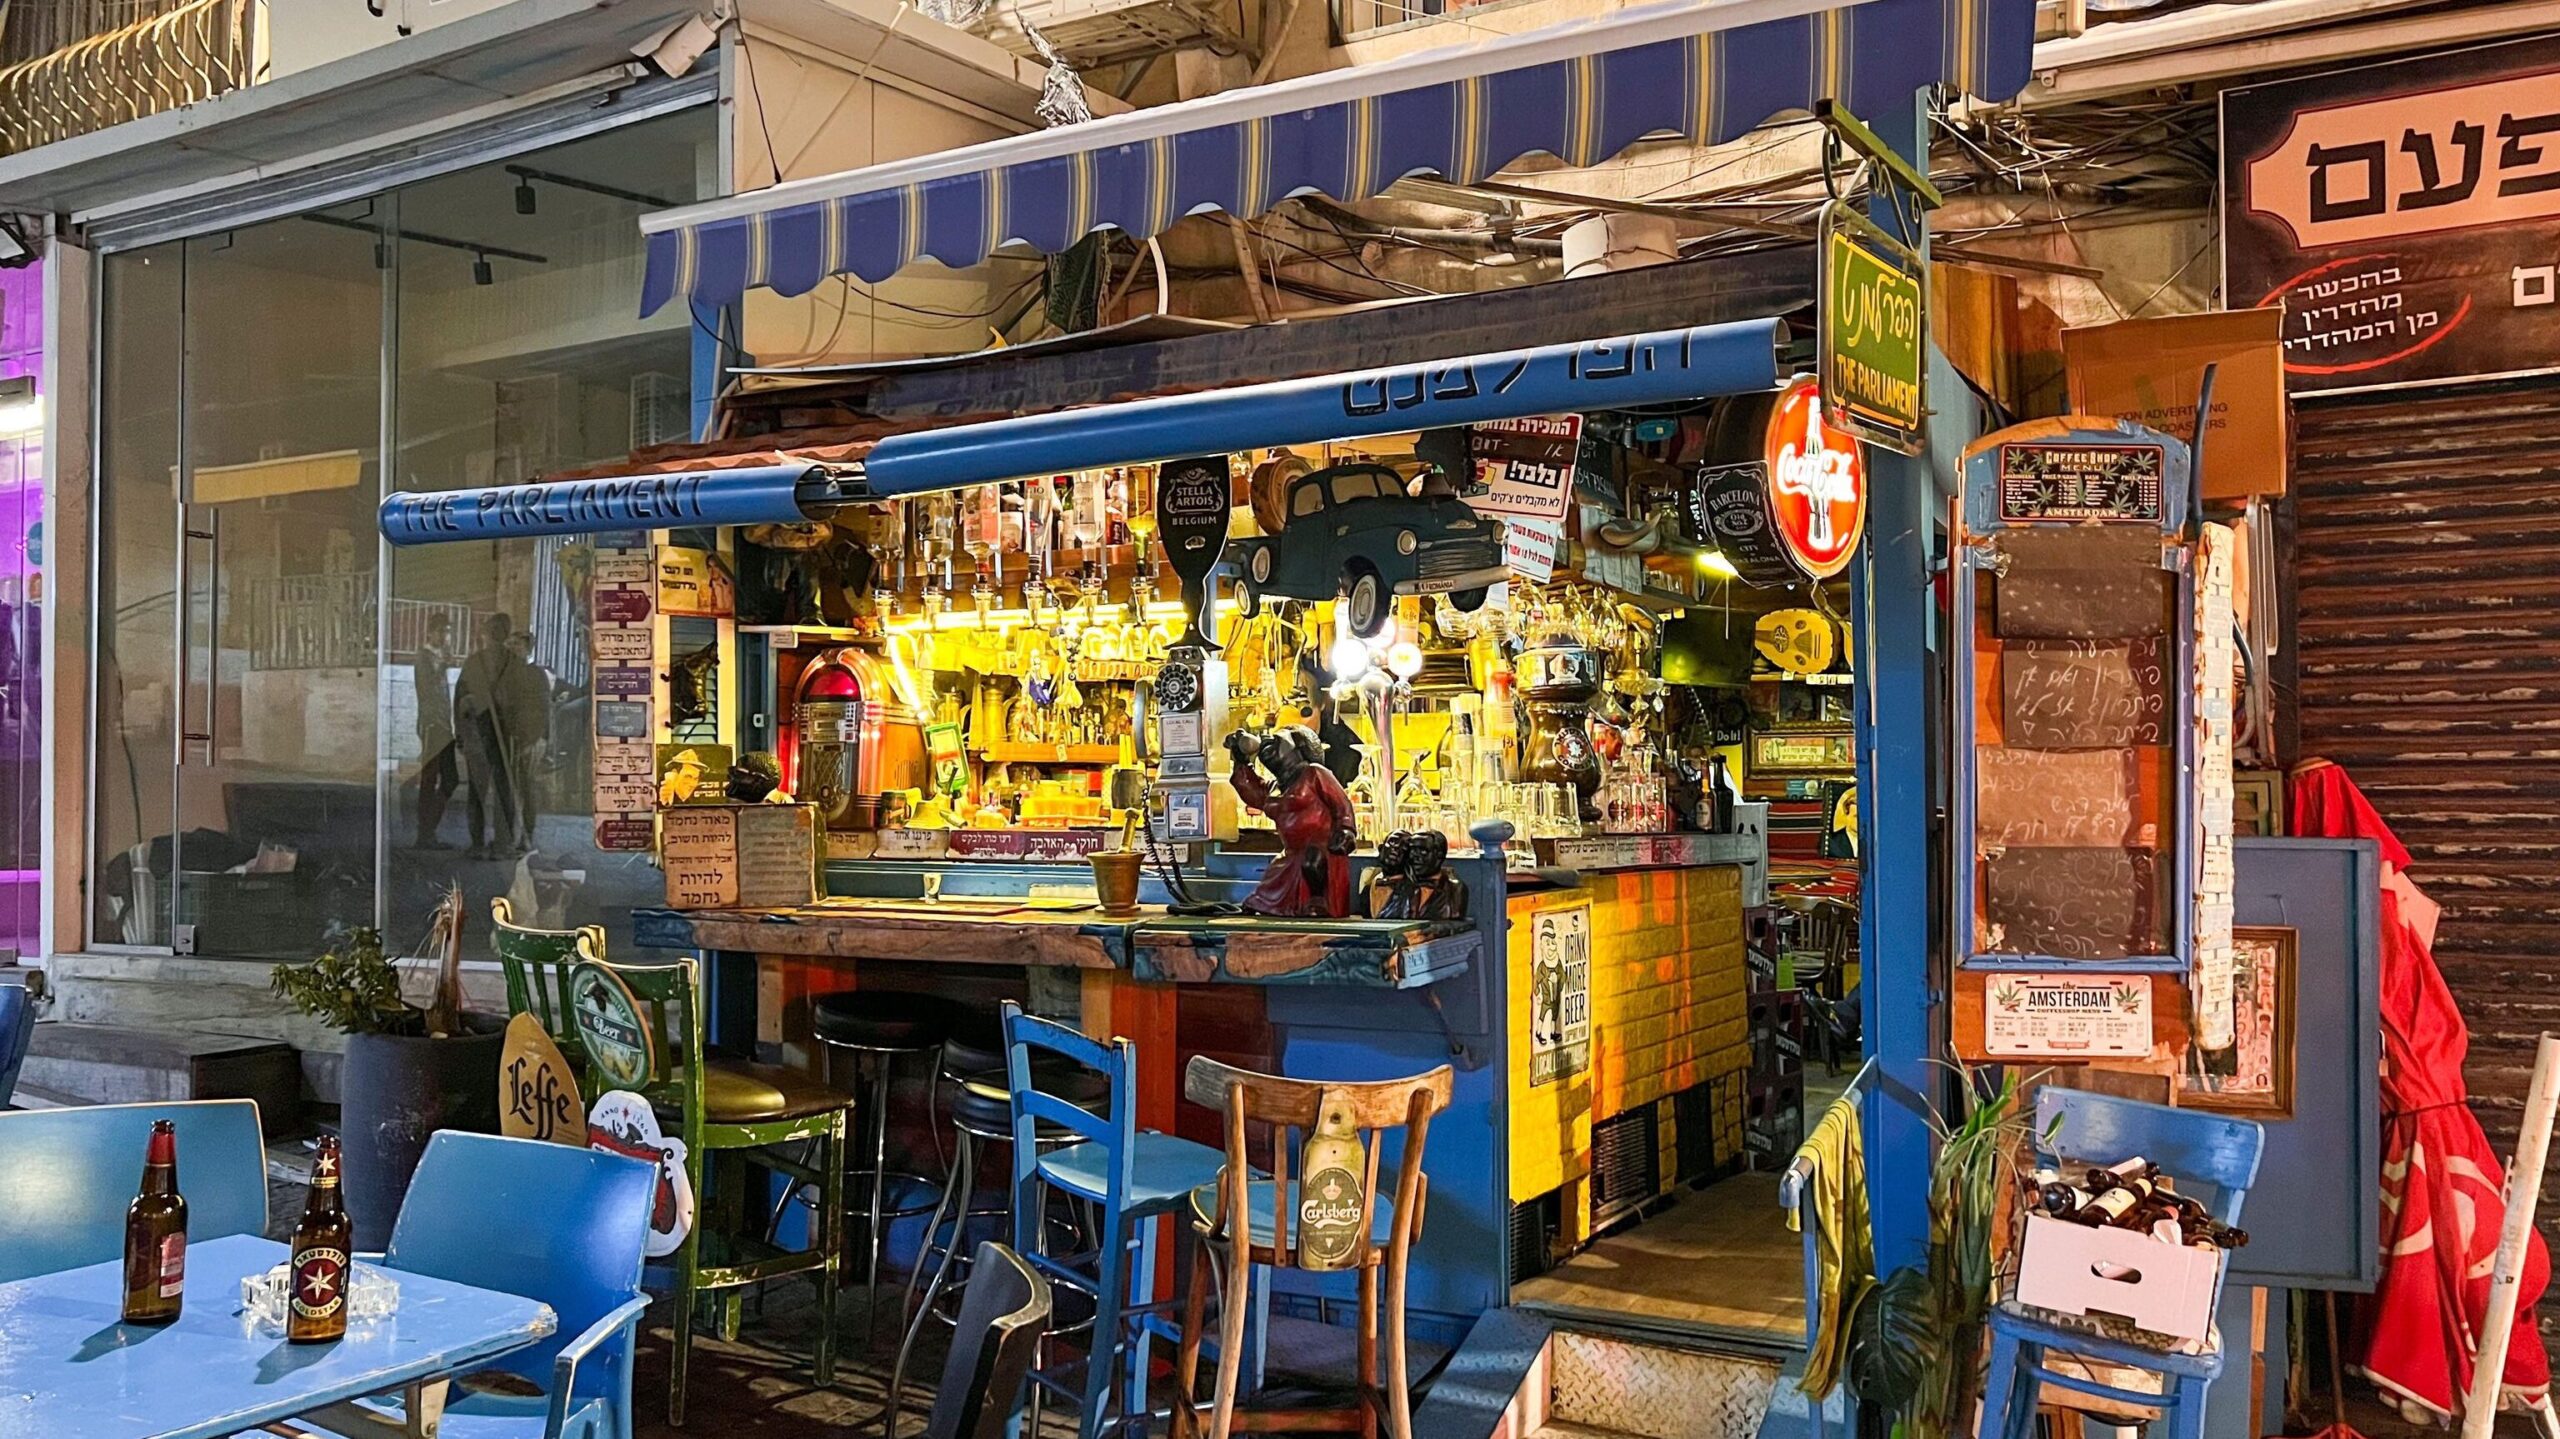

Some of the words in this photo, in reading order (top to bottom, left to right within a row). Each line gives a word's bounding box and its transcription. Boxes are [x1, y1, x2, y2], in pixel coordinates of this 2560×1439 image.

[2297, 267, 2402, 300] בהכשר
[2302, 293, 2402, 331] מהדרין
[2406, 311, 2438, 334] מן
[2284, 318, 2395, 351] המהדרי
[1837, 353, 1855, 392] THE
[1858, 365, 1917, 418] PARLIAMENT
[1521, 419, 1571, 435] המכירה
[2159, 419, 2226, 432] COASERS
[2046, 452, 2087, 464] COFFEE
[2090, 452, 2118, 464] SHOP
[1510, 460, 1556, 485] בלבד!
[1176, 486, 1213, 496] STELLA
[403, 497, 459, 532] THE
[477, 475, 709, 527] PARLIAMENT
[1175, 496, 1214, 506] ARTOIS
[1516, 494, 1547, 507] מקבלים
[1549, 496, 1560, 507] לא
[1710, 490, 1759, 511] BARCELONA
[2044, 508, 2119, 517] AMSTERDAM
[1172, 516, 1216, 526] BELGIUM
[628, 634, 646, 642] זכרו
[1717, 730, 1729, 740] Do
[1730, 729, 1740, 740] It!
[600, 786, 620, 794] אחד
[613, 796, 636, 808] לשני
[667, 816, 699, 826] נחמד
[702, 815, 730, 825] מאוד
[702, 832, 731, 844] להיות
[1031, 838, 1064, 849] האהבה
[1077, 837, 1098, 852] חוקי
[715, 854, 732, 863] אבל
[680, 869, 723, 885] להיות
[681, 891, 720, 904] נחמד
[1565, 931, 1587, 964] DRINK
[1565, 962, 1586, 995] MORE
[2062, 981, 2076, 990] the
[2028, 991, 2111, 1008] AMSTERDAM
[507, 1057, 570, 1140] Leffe
[601, 1106, 619, 1123] ANNO
[1301, 1199, 1361, 1229] Carlsberg
[295, 1299, 340, 1317] GOLDSTAR
